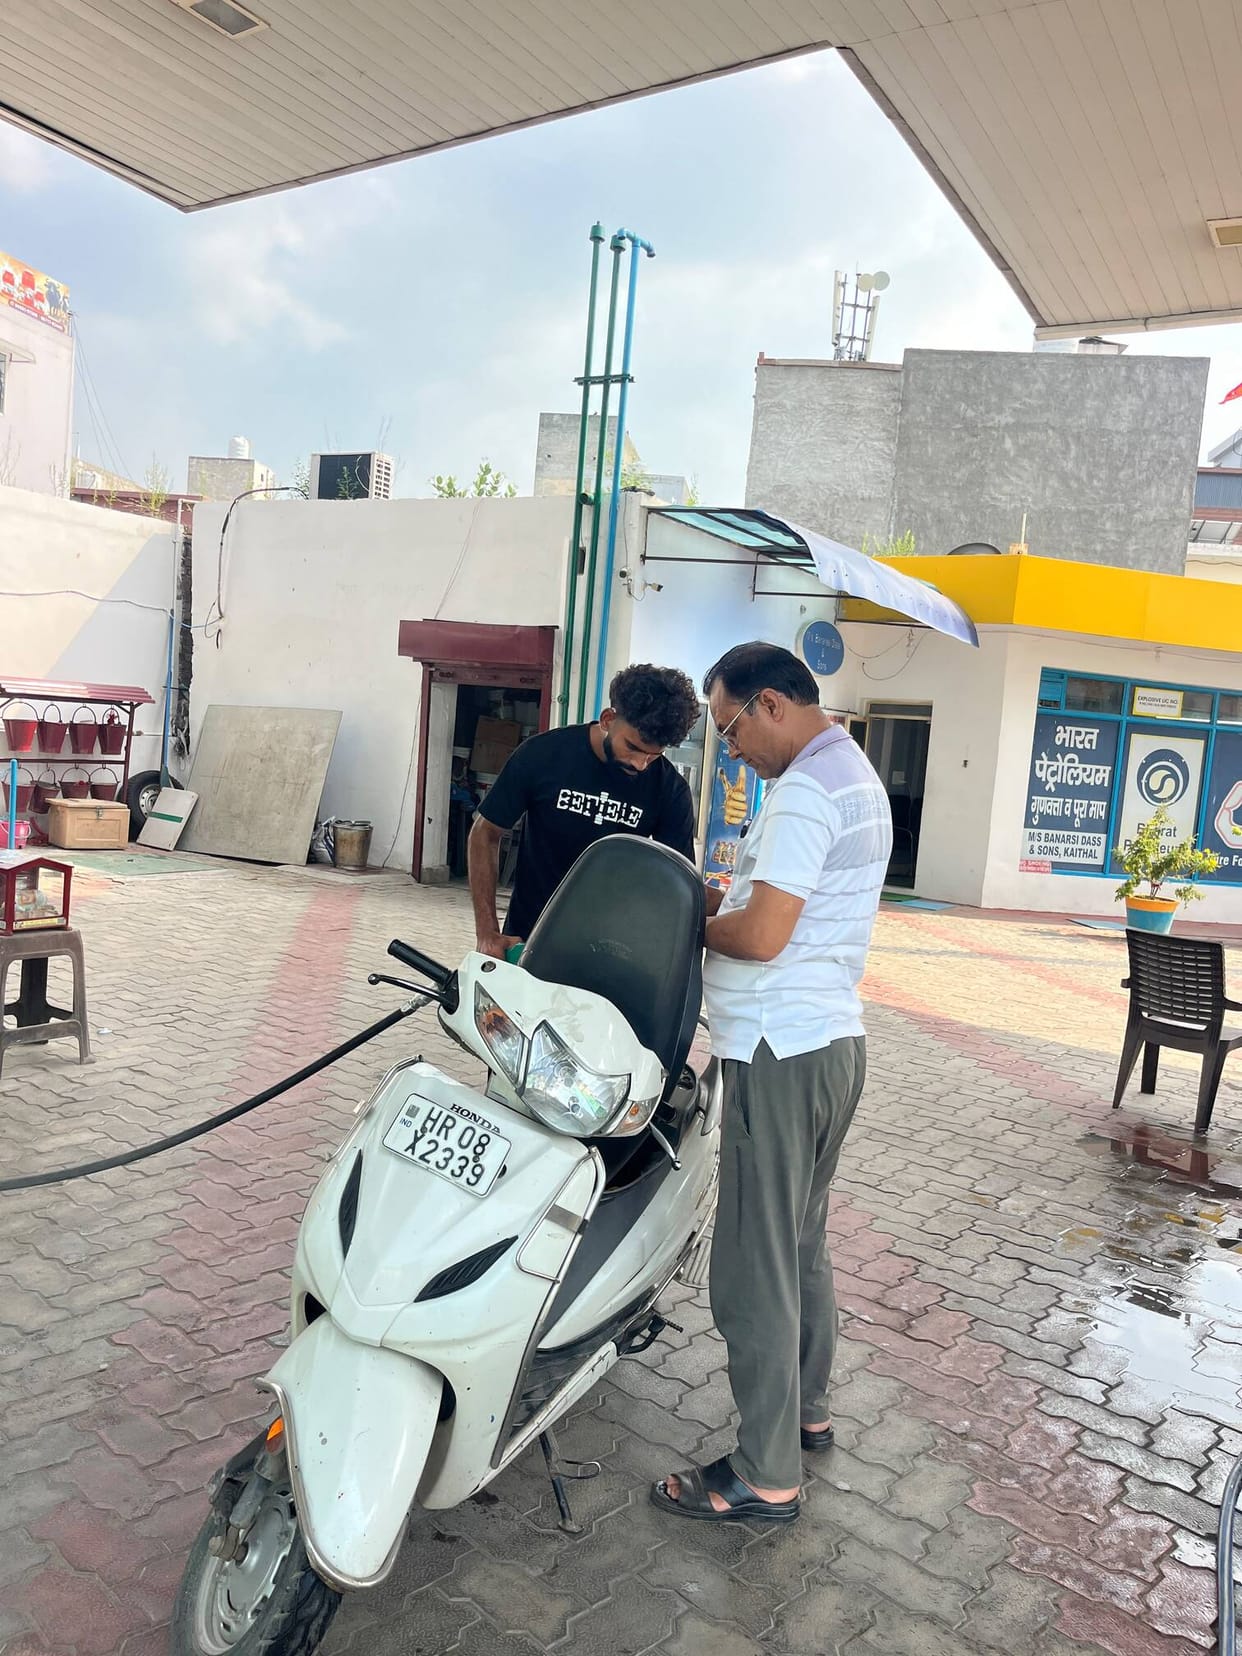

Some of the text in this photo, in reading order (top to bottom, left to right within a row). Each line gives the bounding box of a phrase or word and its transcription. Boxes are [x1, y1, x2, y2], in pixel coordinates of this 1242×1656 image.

[1055, 725, 1099, 750] भारत
[1035, 752, 1111, 792] पेट्रोलियम
[1064, 798, 1072, 817] व
[1073, 799, 1088, 828] पूरा
[1088, 800, 1107, 820] माप
[1044, 833, 1079, 845] BANARSI
[1081, 836, 1102, 847] DASS
[1136, 823, 1177, 837] Brat
[1029, 845, 1098, 859] & SONS, KAITHAL
[400, 1118, 412, 1128] IND
[421, 1107, 491, 1156] HR 08
[450, 1103, 501, 1133] HONDA
[404, 1130, 485, 1186] X2339
